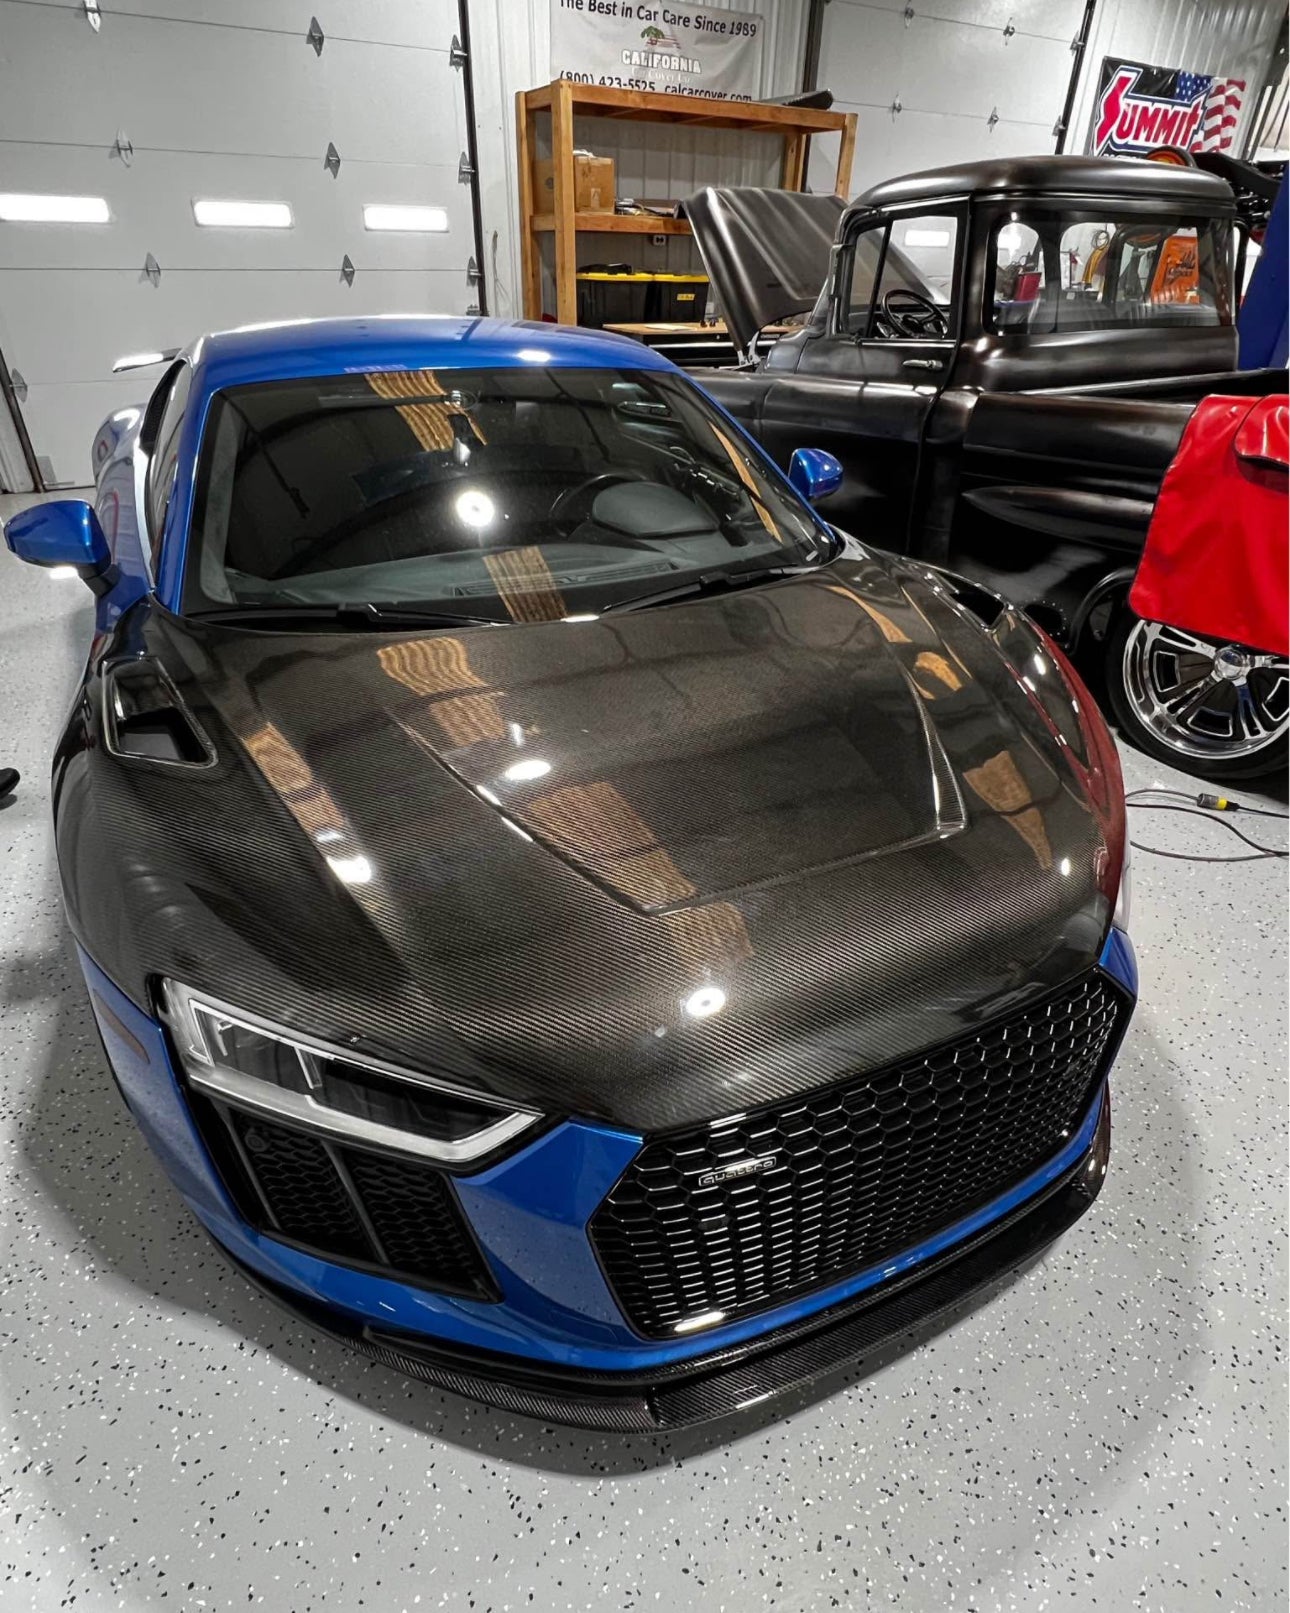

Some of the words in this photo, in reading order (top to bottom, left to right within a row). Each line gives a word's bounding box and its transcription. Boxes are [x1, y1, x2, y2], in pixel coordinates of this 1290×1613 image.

[588, 0, 618, 16] Best
[621, 2, 633, 18] in
[636, 5, 659, 21] Car
[662, 9, 691, 28] Care
[694, 15, 727, 34] Since
[729, 21, 757, 37] 1989
[622, 49, 702, 74] CALIFORNIA
[1095, 71, 1205, 150] SUMMIT
[703, 1160, 774, 1184] quattro
